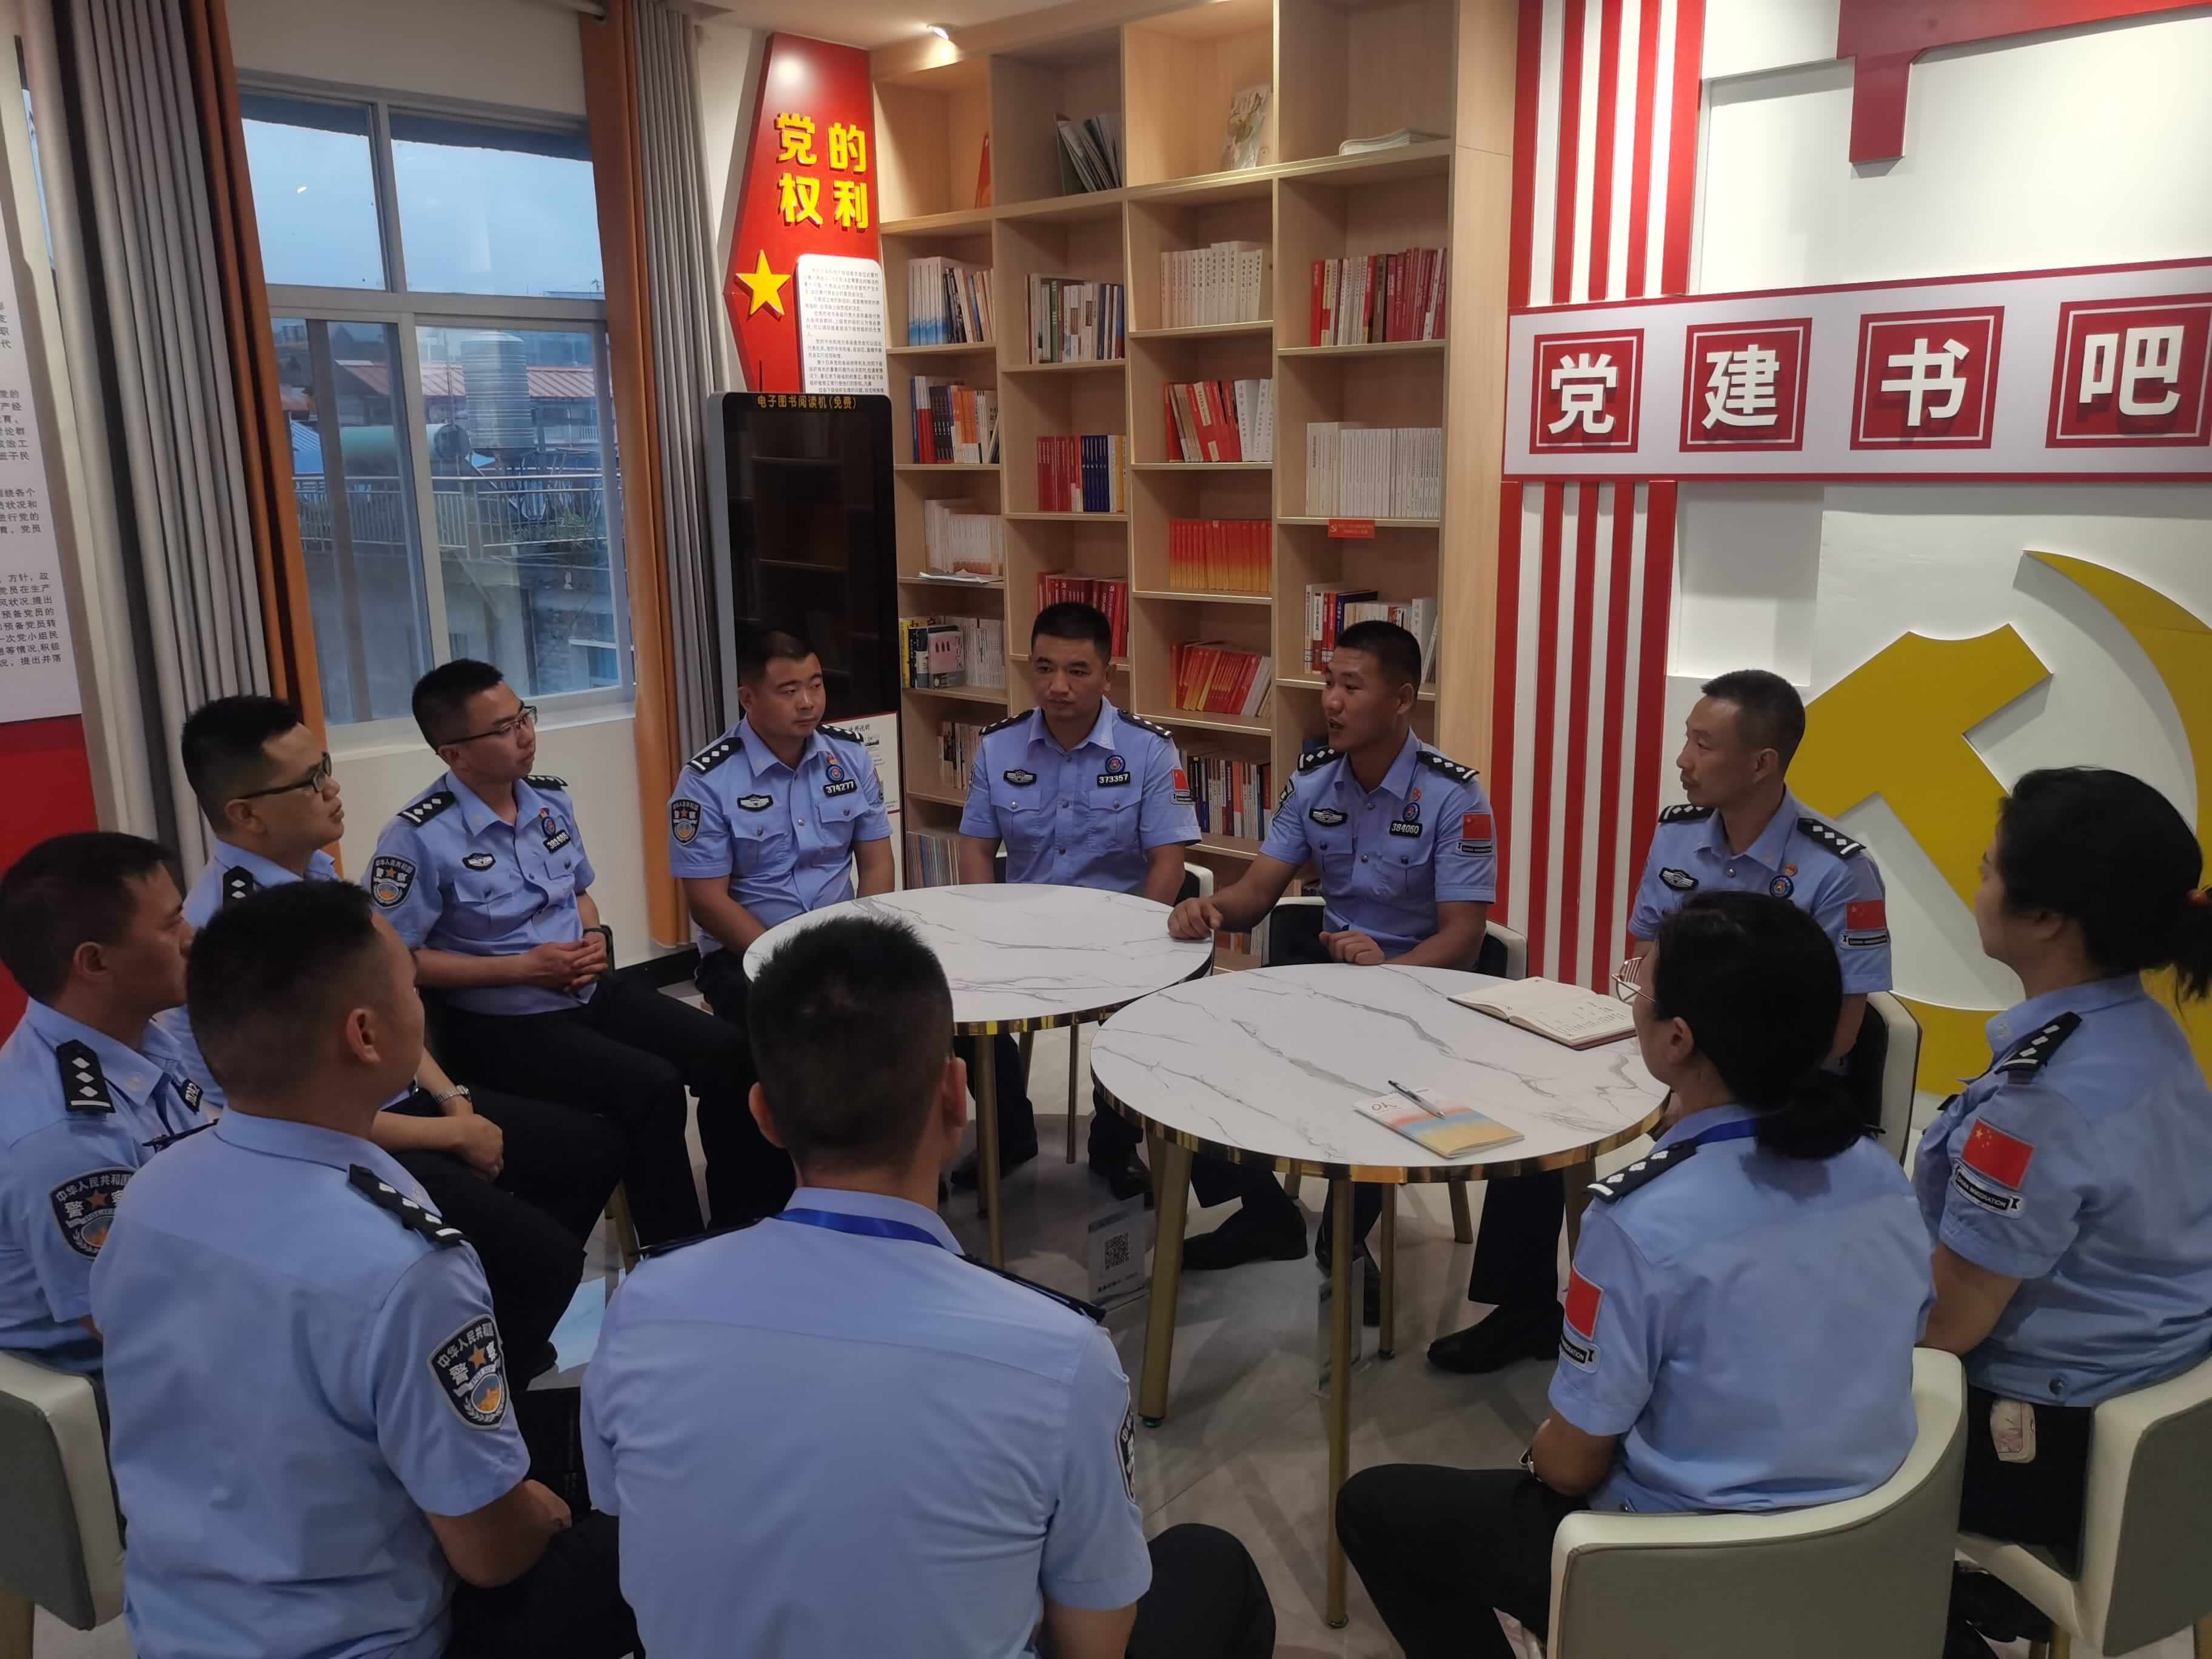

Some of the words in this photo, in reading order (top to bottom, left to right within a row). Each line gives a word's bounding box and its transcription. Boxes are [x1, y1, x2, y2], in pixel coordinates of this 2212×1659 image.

[775, 111, 867, 173] 党的
[779, 173, 870, 229] 权利
[0, 619, 56, 631] 预备党员转
[1099, 773, 1128, 783] 373357
[826, 781, 854, 793] 374277
